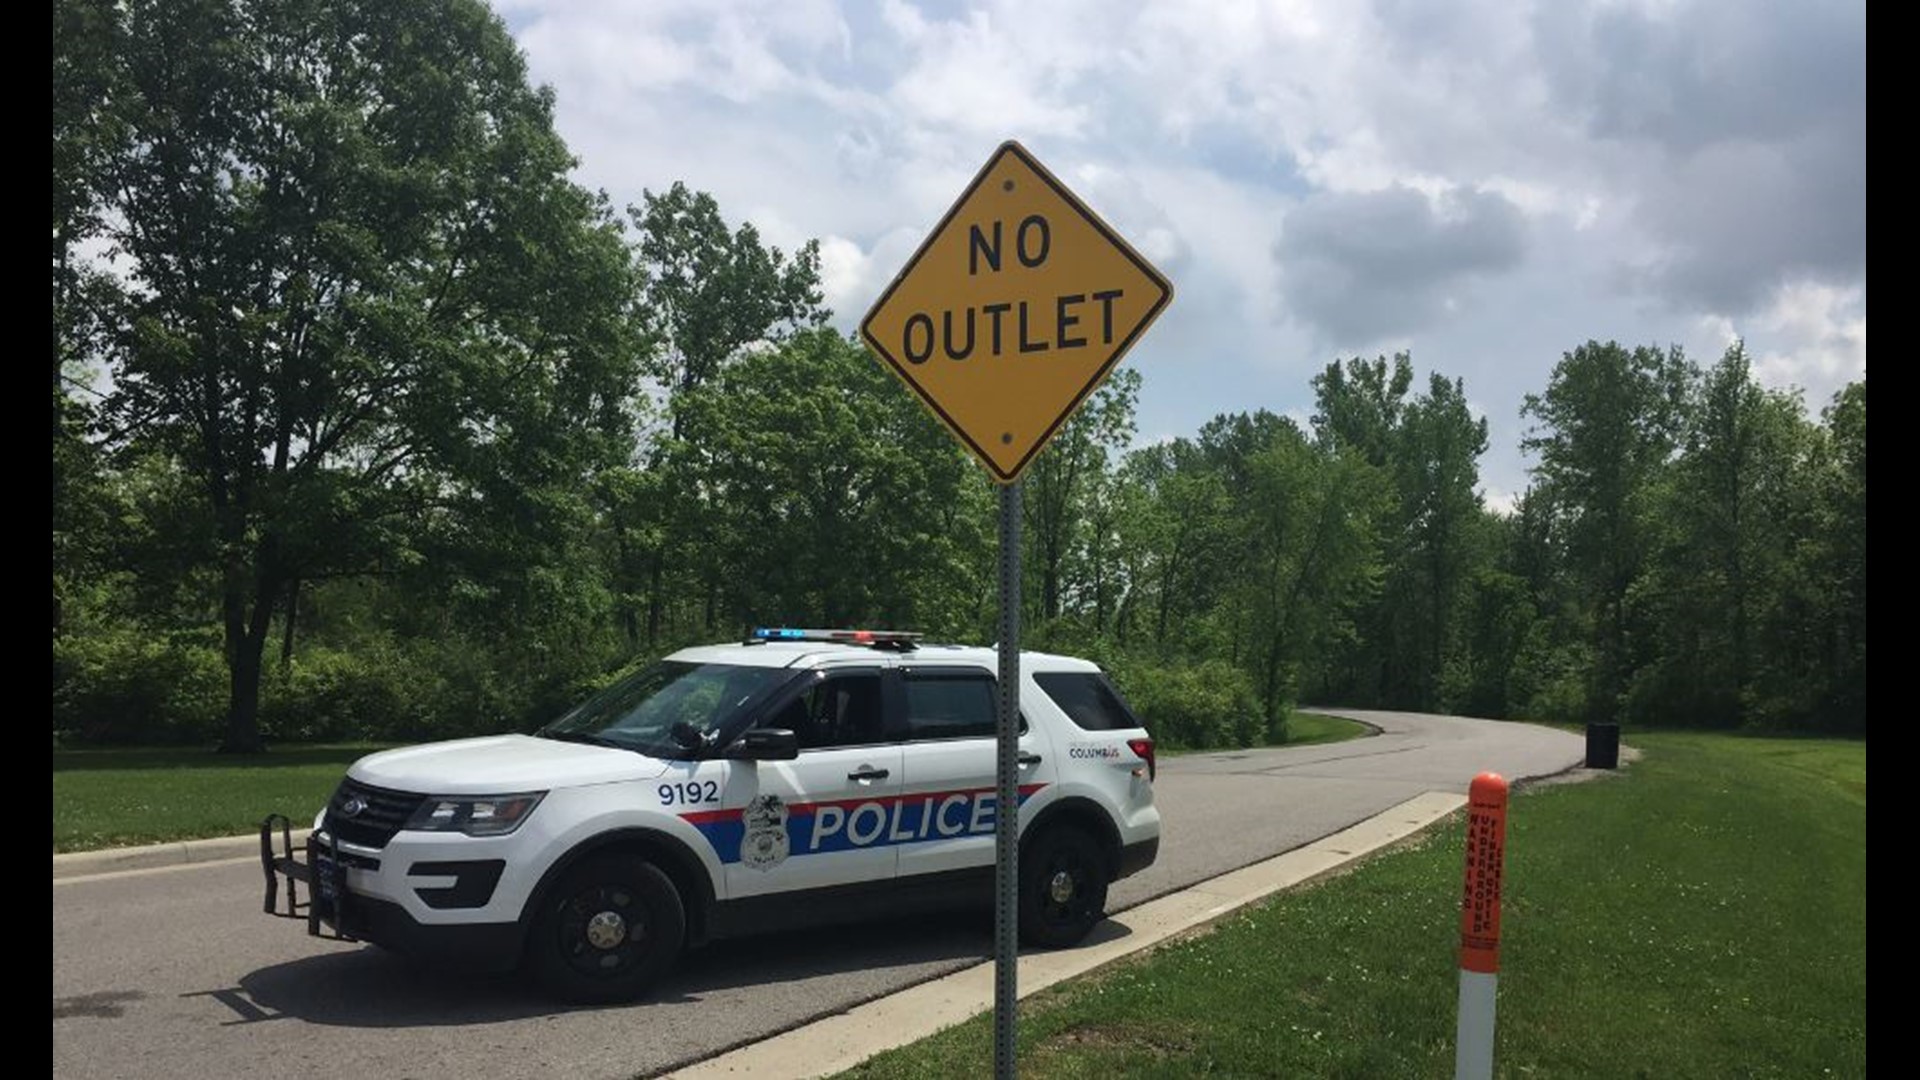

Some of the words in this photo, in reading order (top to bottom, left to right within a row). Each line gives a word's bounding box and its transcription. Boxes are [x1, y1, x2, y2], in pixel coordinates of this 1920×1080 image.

[968, 214, 1051, 275] NO
[903, 289, 1124, 365] OUTLET
[1069, 746, 1120, 759] COLUMBUS
[658, 780, 719, 806] 9192
[809, 792, 997, 850] POLICE
[1464, 814, 1479, 909] WARNING
[1473, 815, 1490, 933] UNDERGROUND
[1483, 878, 1494, 930] OPTIC
